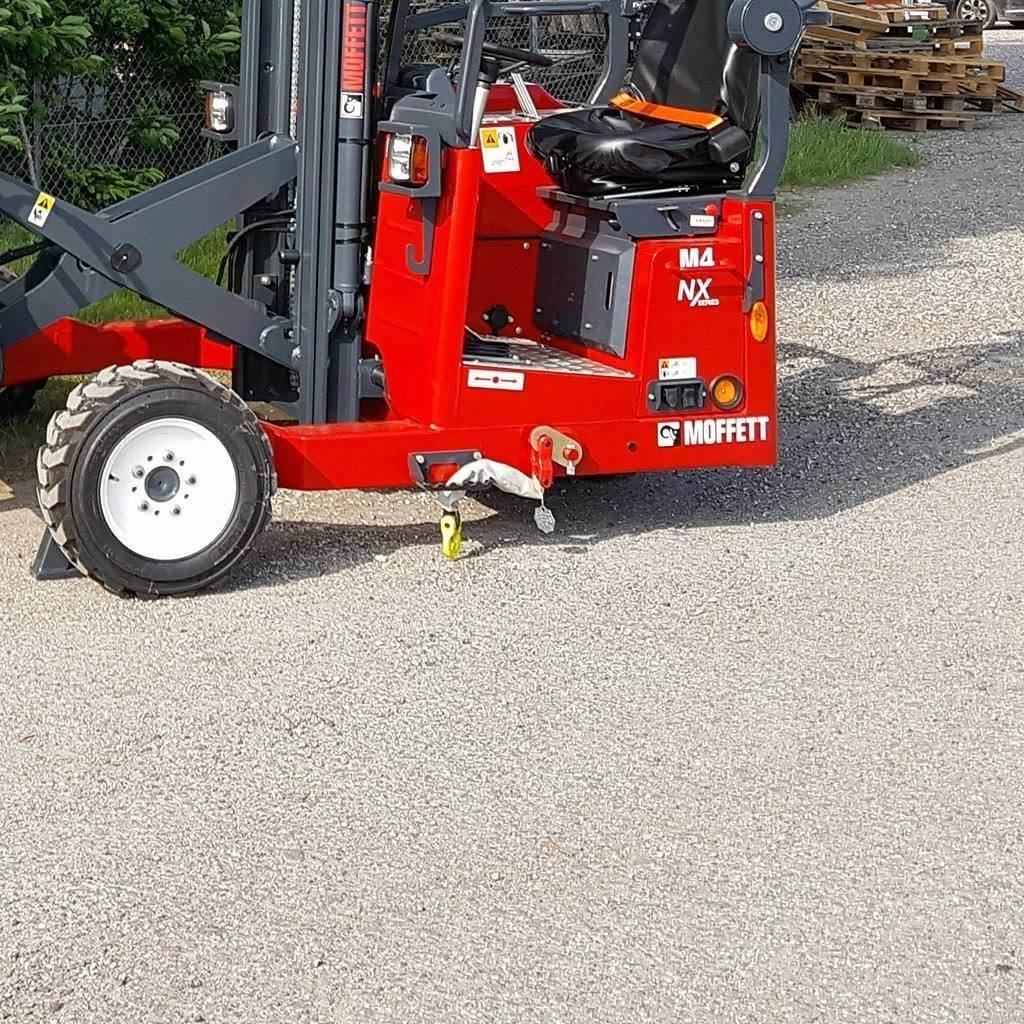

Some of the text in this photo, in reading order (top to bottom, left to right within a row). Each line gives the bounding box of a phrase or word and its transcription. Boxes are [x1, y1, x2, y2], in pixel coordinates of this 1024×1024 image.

[341, 2, 366, 91] MOFFETT
[679, 247, 715, 268] M4
[677, 278, 713, 307] NX
[683, 416, 770, 446] MOFFETT
